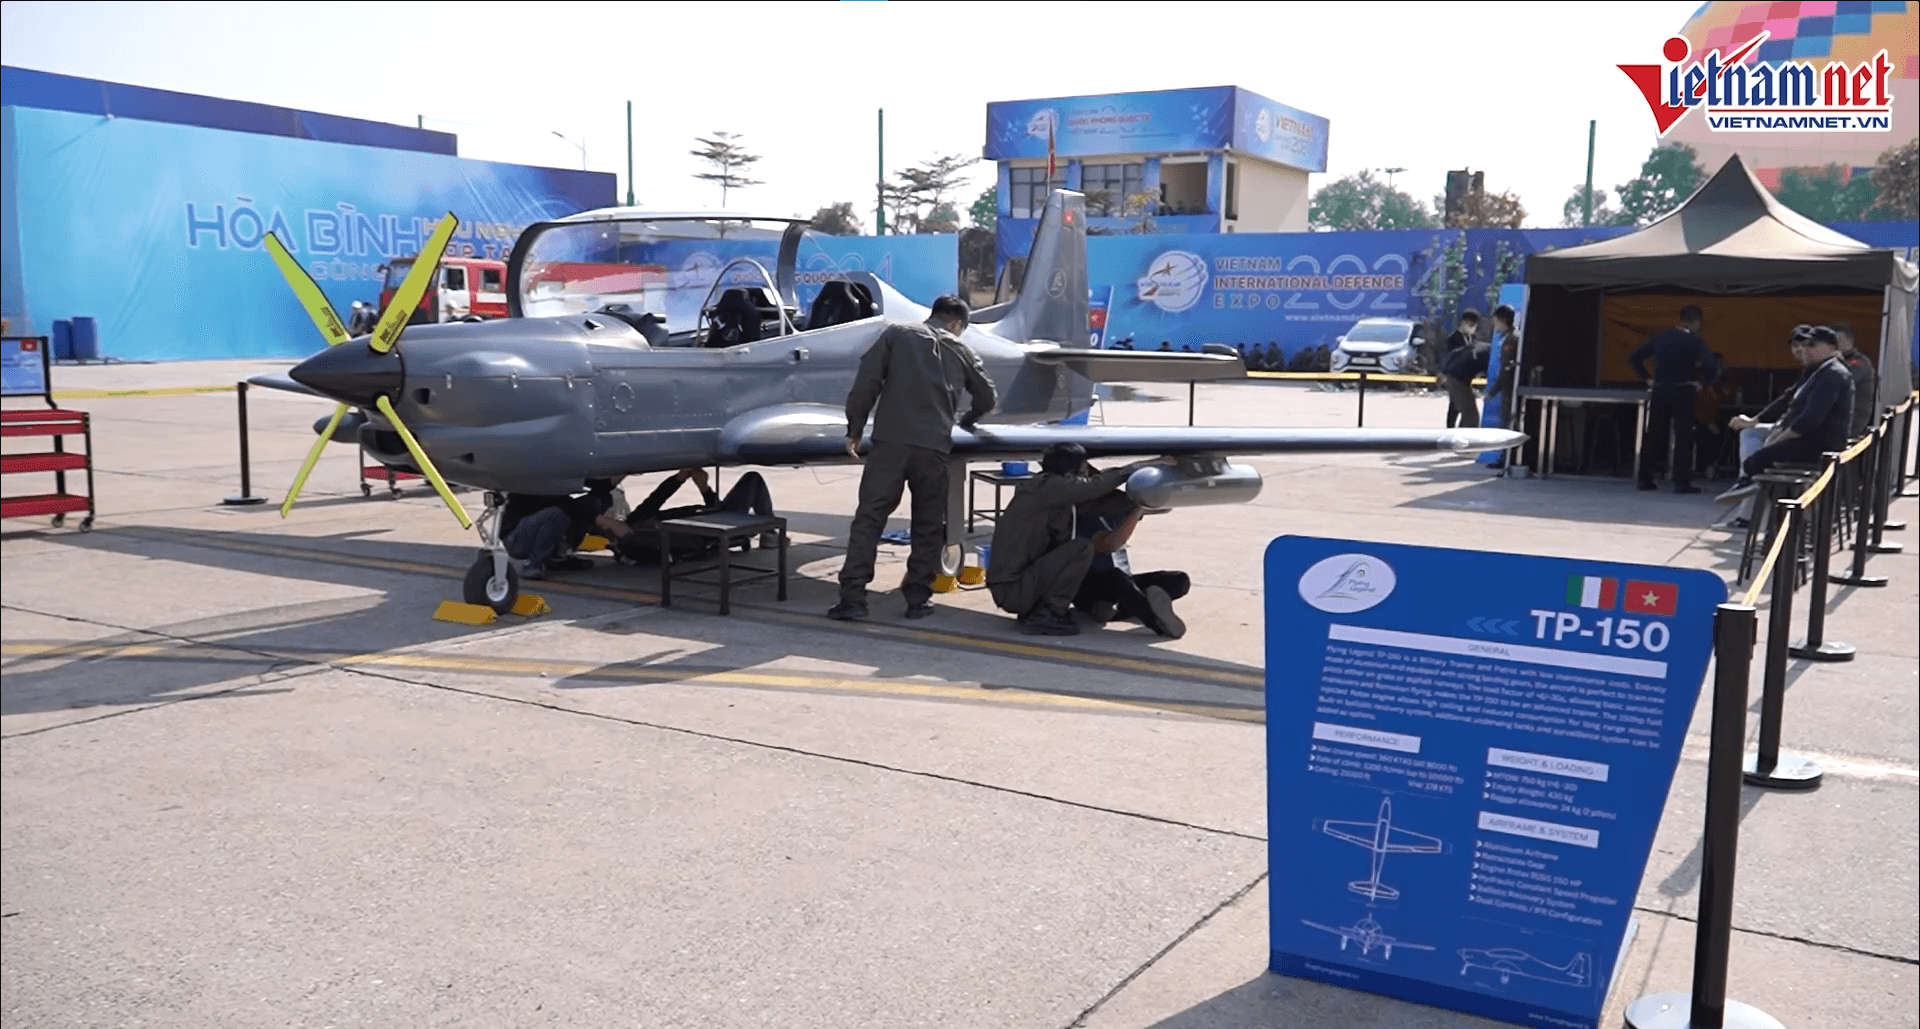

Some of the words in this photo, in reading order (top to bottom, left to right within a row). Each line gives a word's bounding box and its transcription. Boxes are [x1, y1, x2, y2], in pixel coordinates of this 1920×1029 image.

[1215, 257, 1281, 271] VIETNAM
[1214, 276, 1329, 290] INTERNATIONAL
[1334, 276, 1404, 290] DEFENCE
[1215, 295, 1280, 309] EXPO
[1531, 609, 1670, 652] TP-150
